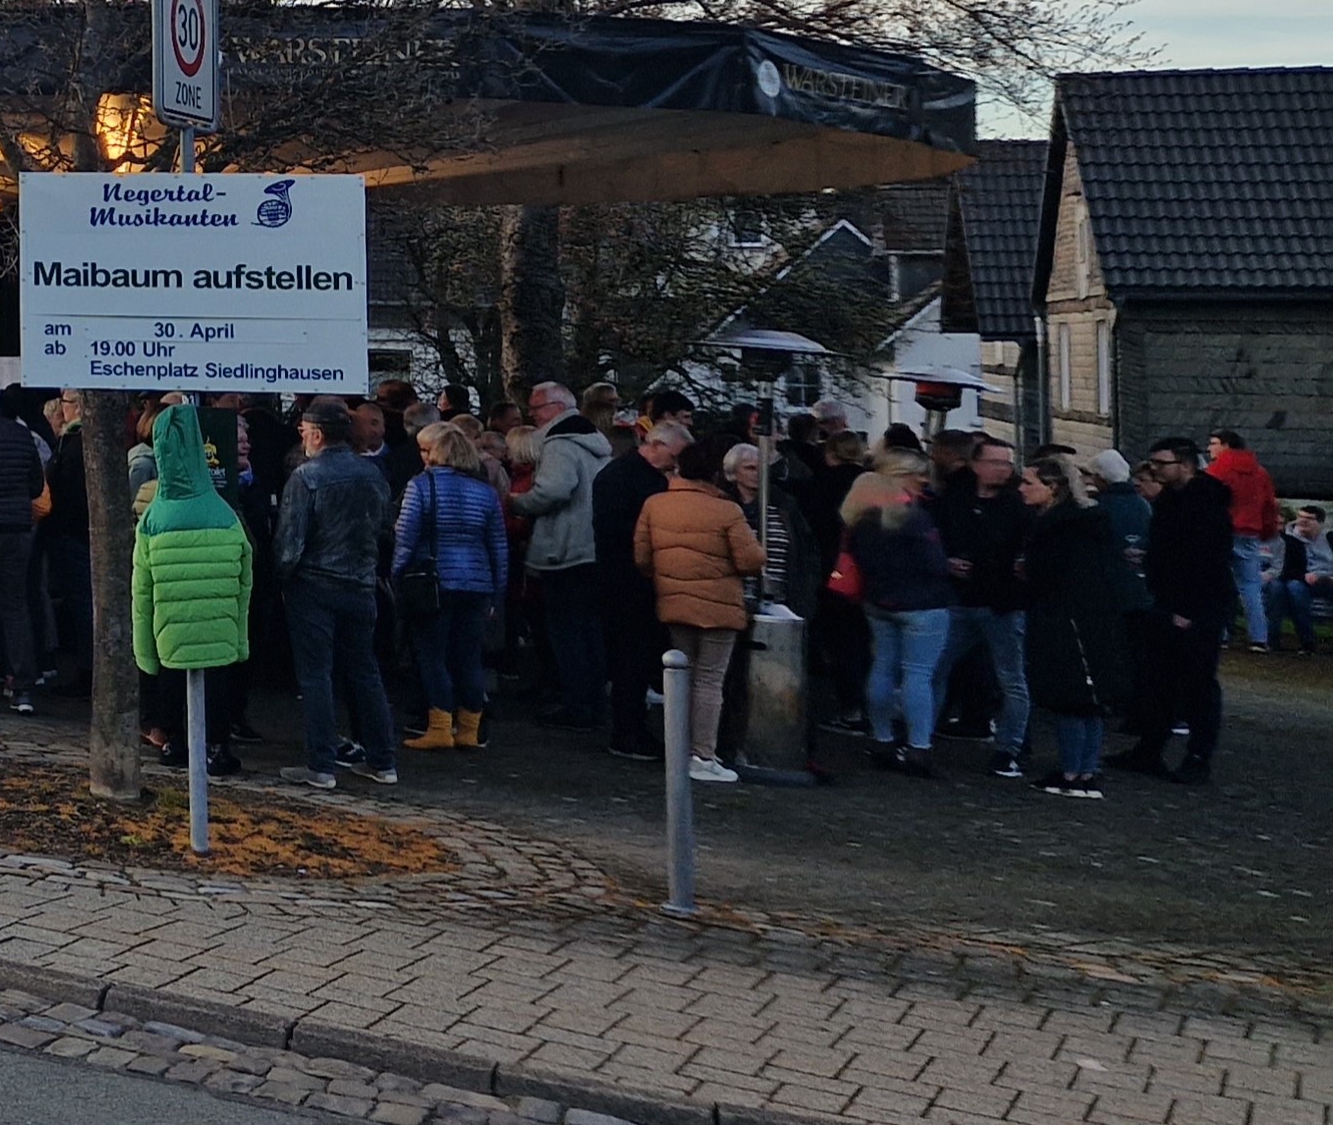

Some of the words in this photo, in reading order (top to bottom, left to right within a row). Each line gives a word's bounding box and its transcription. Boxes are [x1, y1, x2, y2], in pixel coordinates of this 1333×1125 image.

[177, 4, 199, 50] 30
[175, 81, 202, 110] ZONE
[784, 63, 907, 109] WARSTEINER
[103, 183, 227, 206] Negertal-
[90, 207, 240, 227] Musikanten
[33, 261, 183, 288] Maibaum
[192, 264, 354, 291] aufstellen
[44, 324, 72, 336] am
[190, 323, 235, 340] April
[44, 341, 66, 355] ab
[90, 341, 136, 357] 19.00
[143, 342, 176, 357] Uhr
[90, 361, 199, 380] Eschenplatz
[205, 363, 345, 383] Siedlinghausen
